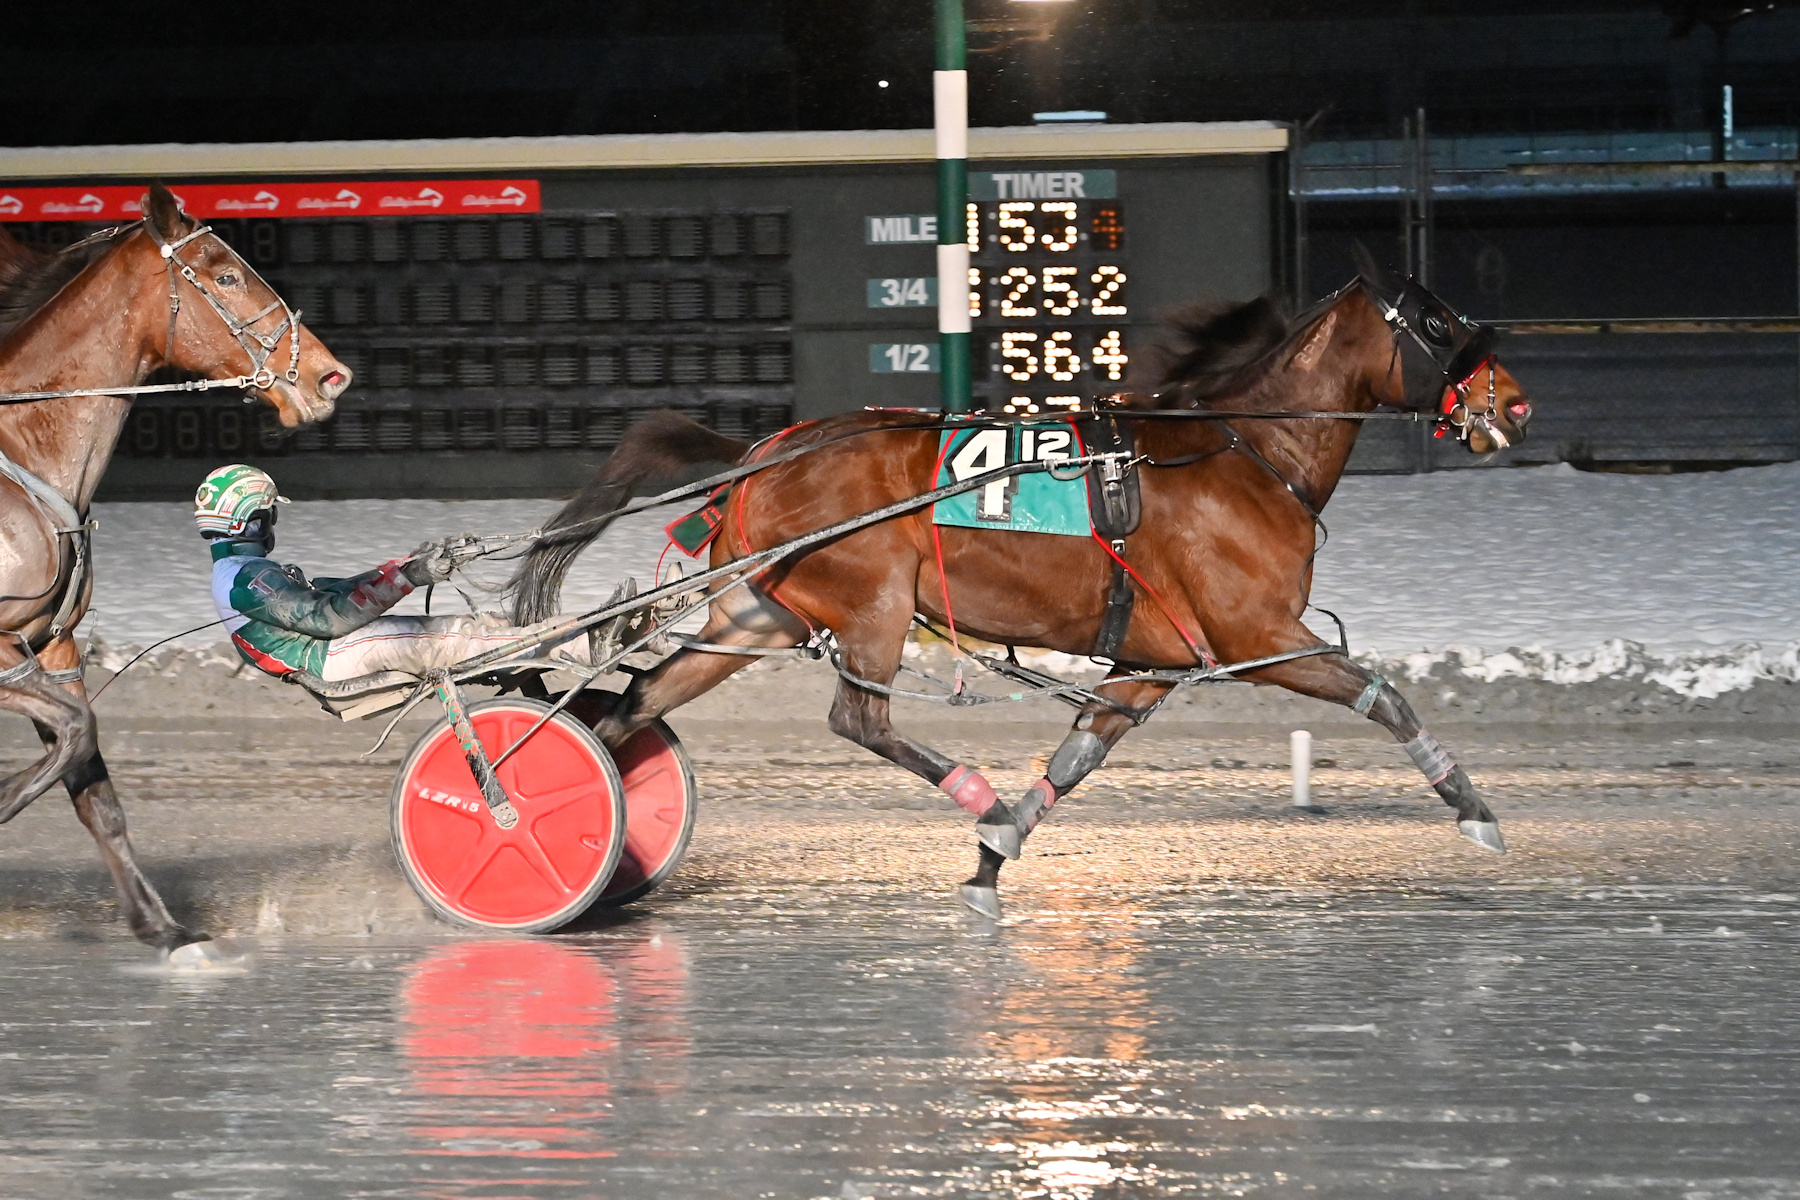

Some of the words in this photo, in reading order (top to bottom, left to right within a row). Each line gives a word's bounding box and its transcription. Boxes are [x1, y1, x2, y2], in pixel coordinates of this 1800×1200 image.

[992, 172, 1086, 198] TIMER
[870, 217, 938, 242] MILE
[881, 277, 929, 305] 3/4
[885, 344, 931, 371] 1/2
[951, 429, 1011, 516] 4
[1022, 430, 1071, 462] 12
